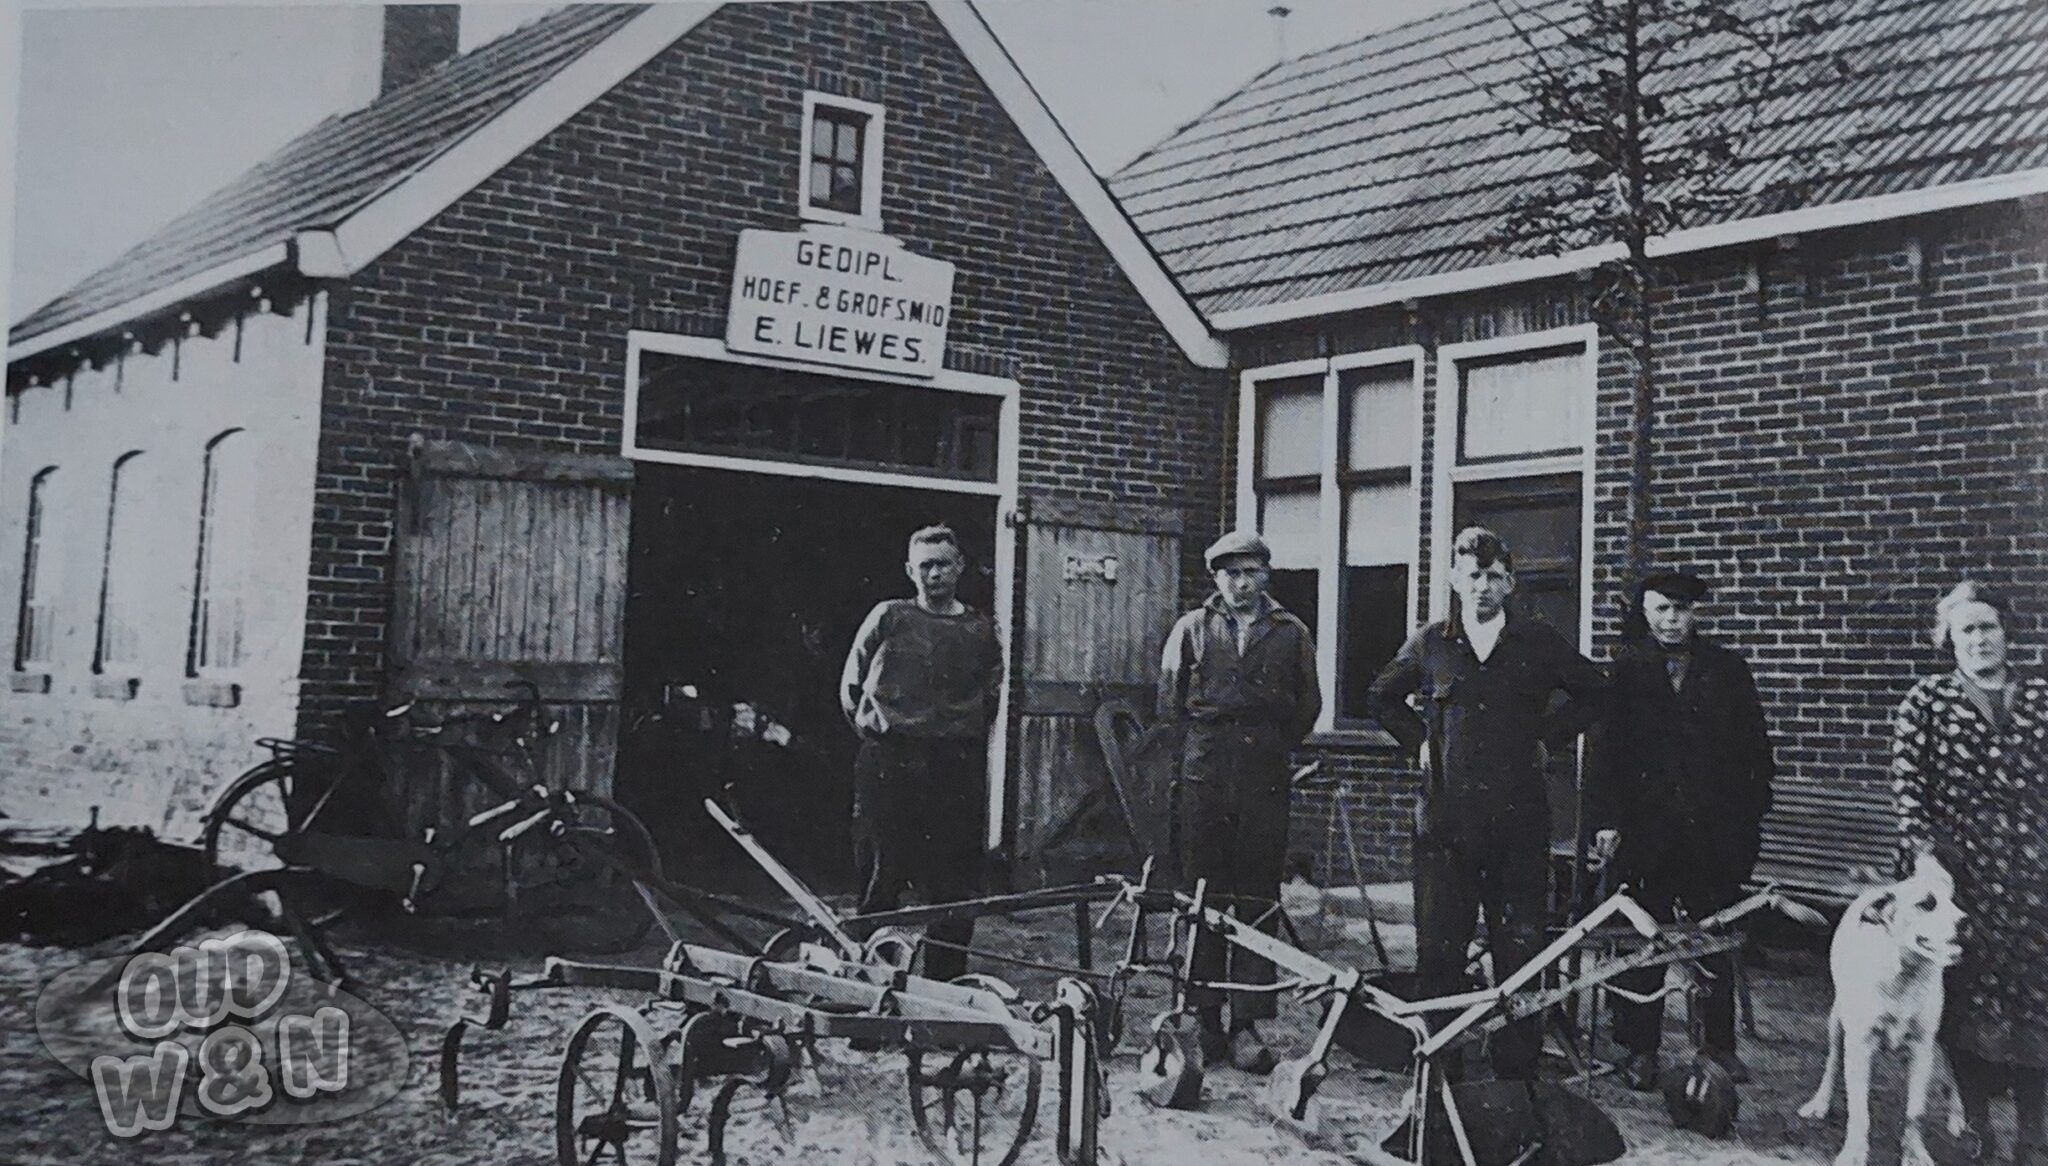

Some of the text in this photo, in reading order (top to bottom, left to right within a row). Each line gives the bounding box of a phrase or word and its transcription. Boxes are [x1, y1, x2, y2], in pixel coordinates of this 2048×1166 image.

[797, 240, 903, 282] GEDIPL.
[816, 286, 830, 309] &
[755, 316, 926, 363] E. LIEWES.
